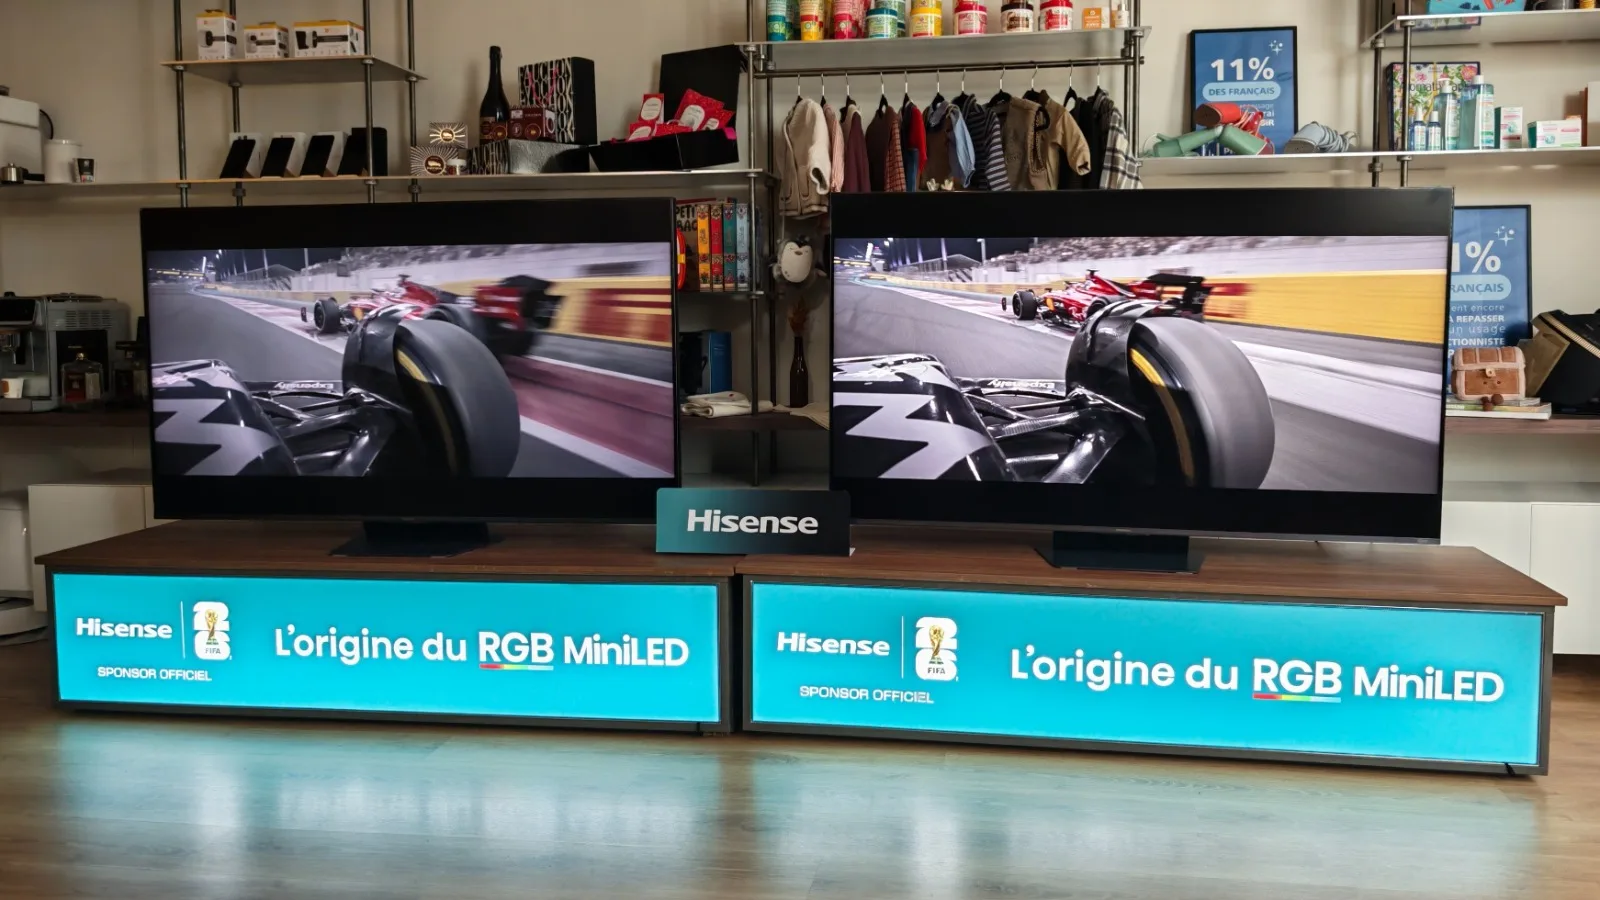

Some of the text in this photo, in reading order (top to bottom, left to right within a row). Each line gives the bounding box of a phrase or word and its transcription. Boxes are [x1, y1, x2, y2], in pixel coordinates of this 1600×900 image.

[1210, 56, 1275, 81] 11%
[1208, 87, 1275, 97] DES FRANÇAIS
[676, 205, 698, 218] PETI
[1451, 240, 1501, 273] 1%
[1450, 283, 1505, 296] RANÇAIS
[1451, 304, 1505, 312] ent encore
[1456, 315, 1505, 323] REPASSER
[1468, 325, 1506, 335] usage
[1448, 337, 1505, 346] CTIONNISTE
[687, 509, 819, 535] Hisense
[76, 617, 173, 639] Hisense
[422, 632, 467, 660] du
[479, 631, 555, 663] RGB
[564, 633, 689, 667] MiniLED
[776, 631, 890, 656] Hisense
[97, 666, 212, 681] SPONSOR OFFICIEL
[927, 667, 946, 675] FIFA
[1185, 657, 1239, 690] du
[1253, 657, 1342, 695] RGB
[1354, 664, 1505, 703] MiniLED
[799, 685, 934, 704] SPONSOR OFFICIEL
